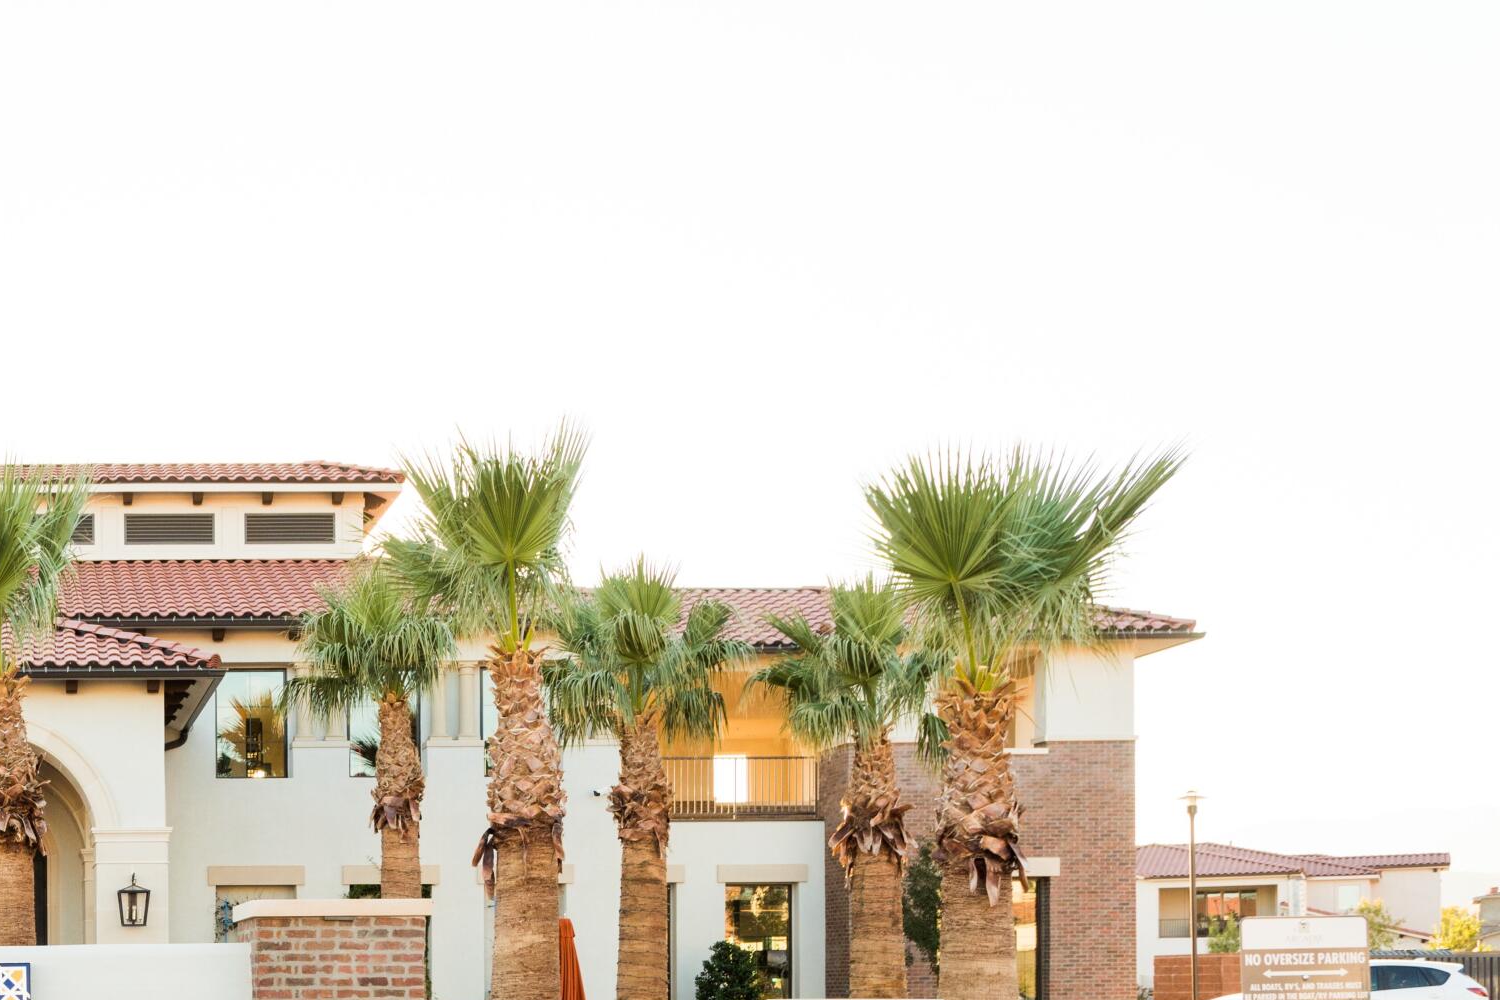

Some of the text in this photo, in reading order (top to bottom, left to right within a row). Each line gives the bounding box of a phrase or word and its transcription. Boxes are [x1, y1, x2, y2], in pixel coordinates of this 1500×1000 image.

[1244, 951, 1366, 966] NO OVERSIZE PARKING
[1250, 983, 1261, 991] ALL
[1301, 982, 1316, 990] AND
[1253, 993, 1277, 1000] PARKED
[1286, 992, 1297, 1000] THE
[1328, 991, 1357, 999] PARKING
